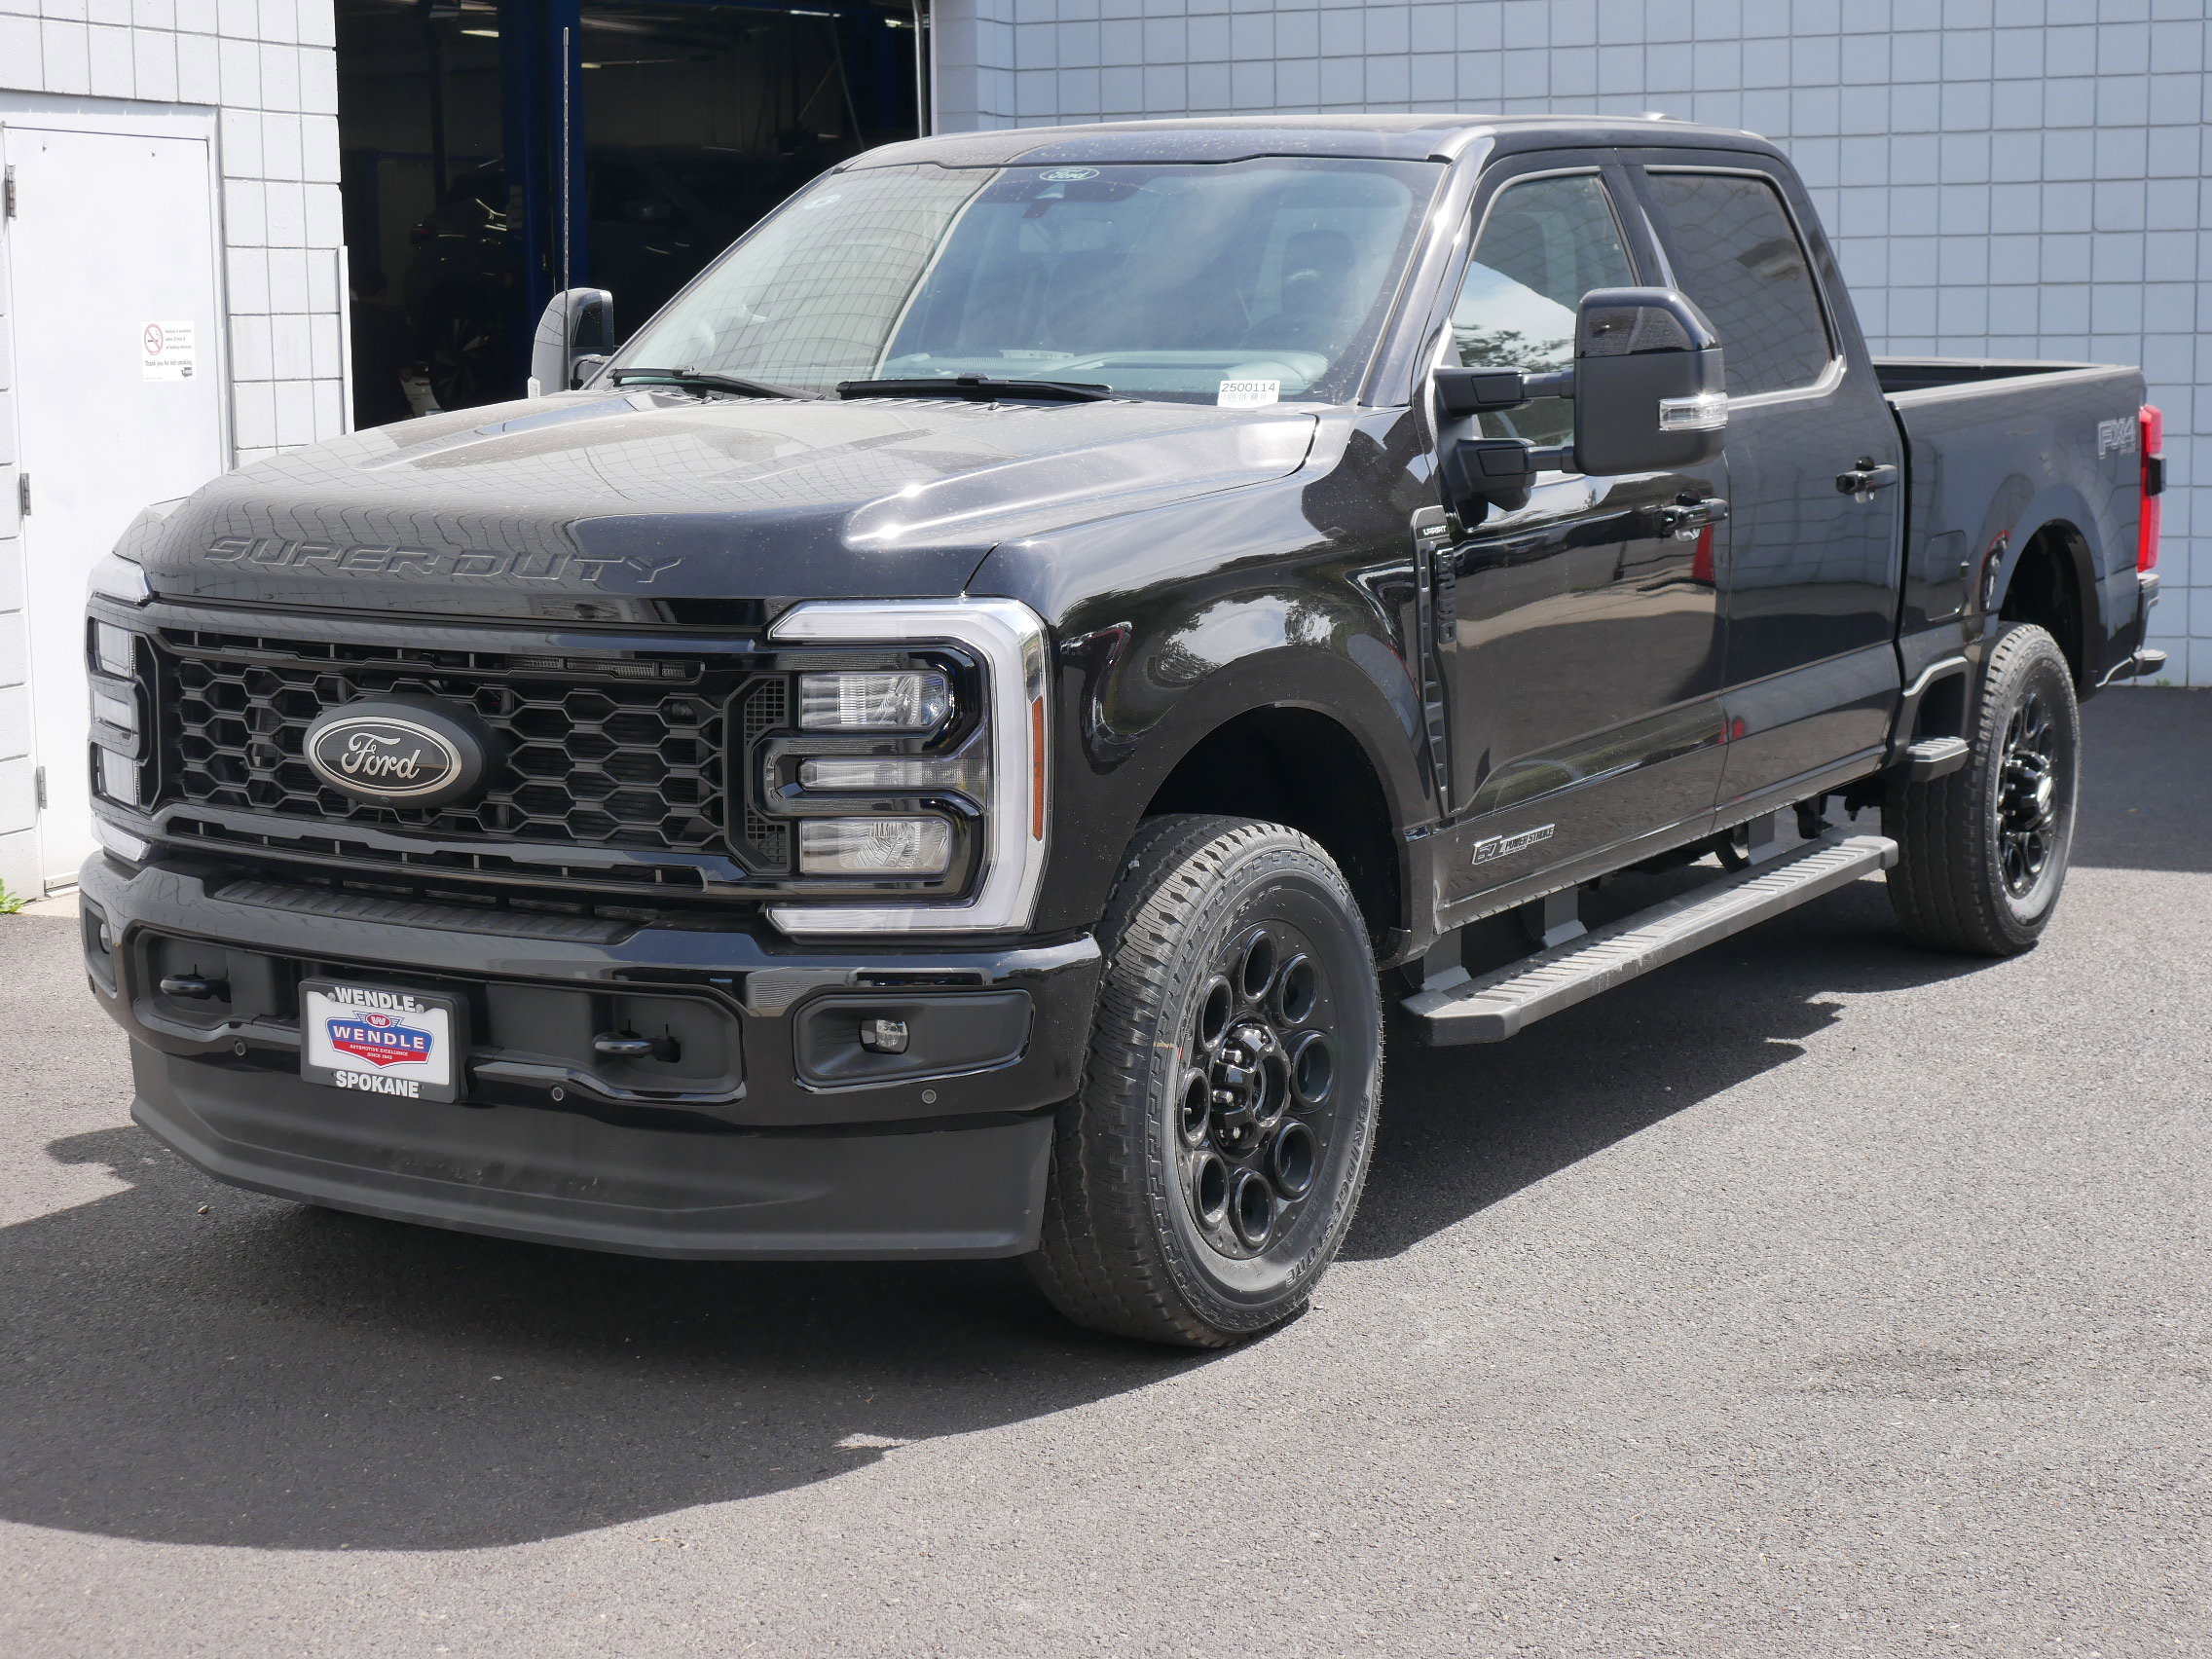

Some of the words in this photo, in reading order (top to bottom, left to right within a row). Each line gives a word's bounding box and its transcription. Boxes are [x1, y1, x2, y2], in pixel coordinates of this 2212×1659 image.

[1221, 382, 1275, 392] 2500114
[2098, 416, 2136, 460] FX4
[204, 535, 440, 574] SUPER
[451, 548, 686, 583] DUTY
[341, 732, 422, 779] Ford
[335, 986, 416, 1013] WENDLE
[333, 1025, 425, 1050] WENDLE
[335, 1070, 420, 1098] SPOKANE
[1285, 1095, 1369, 1287] BRIDGESTONE
